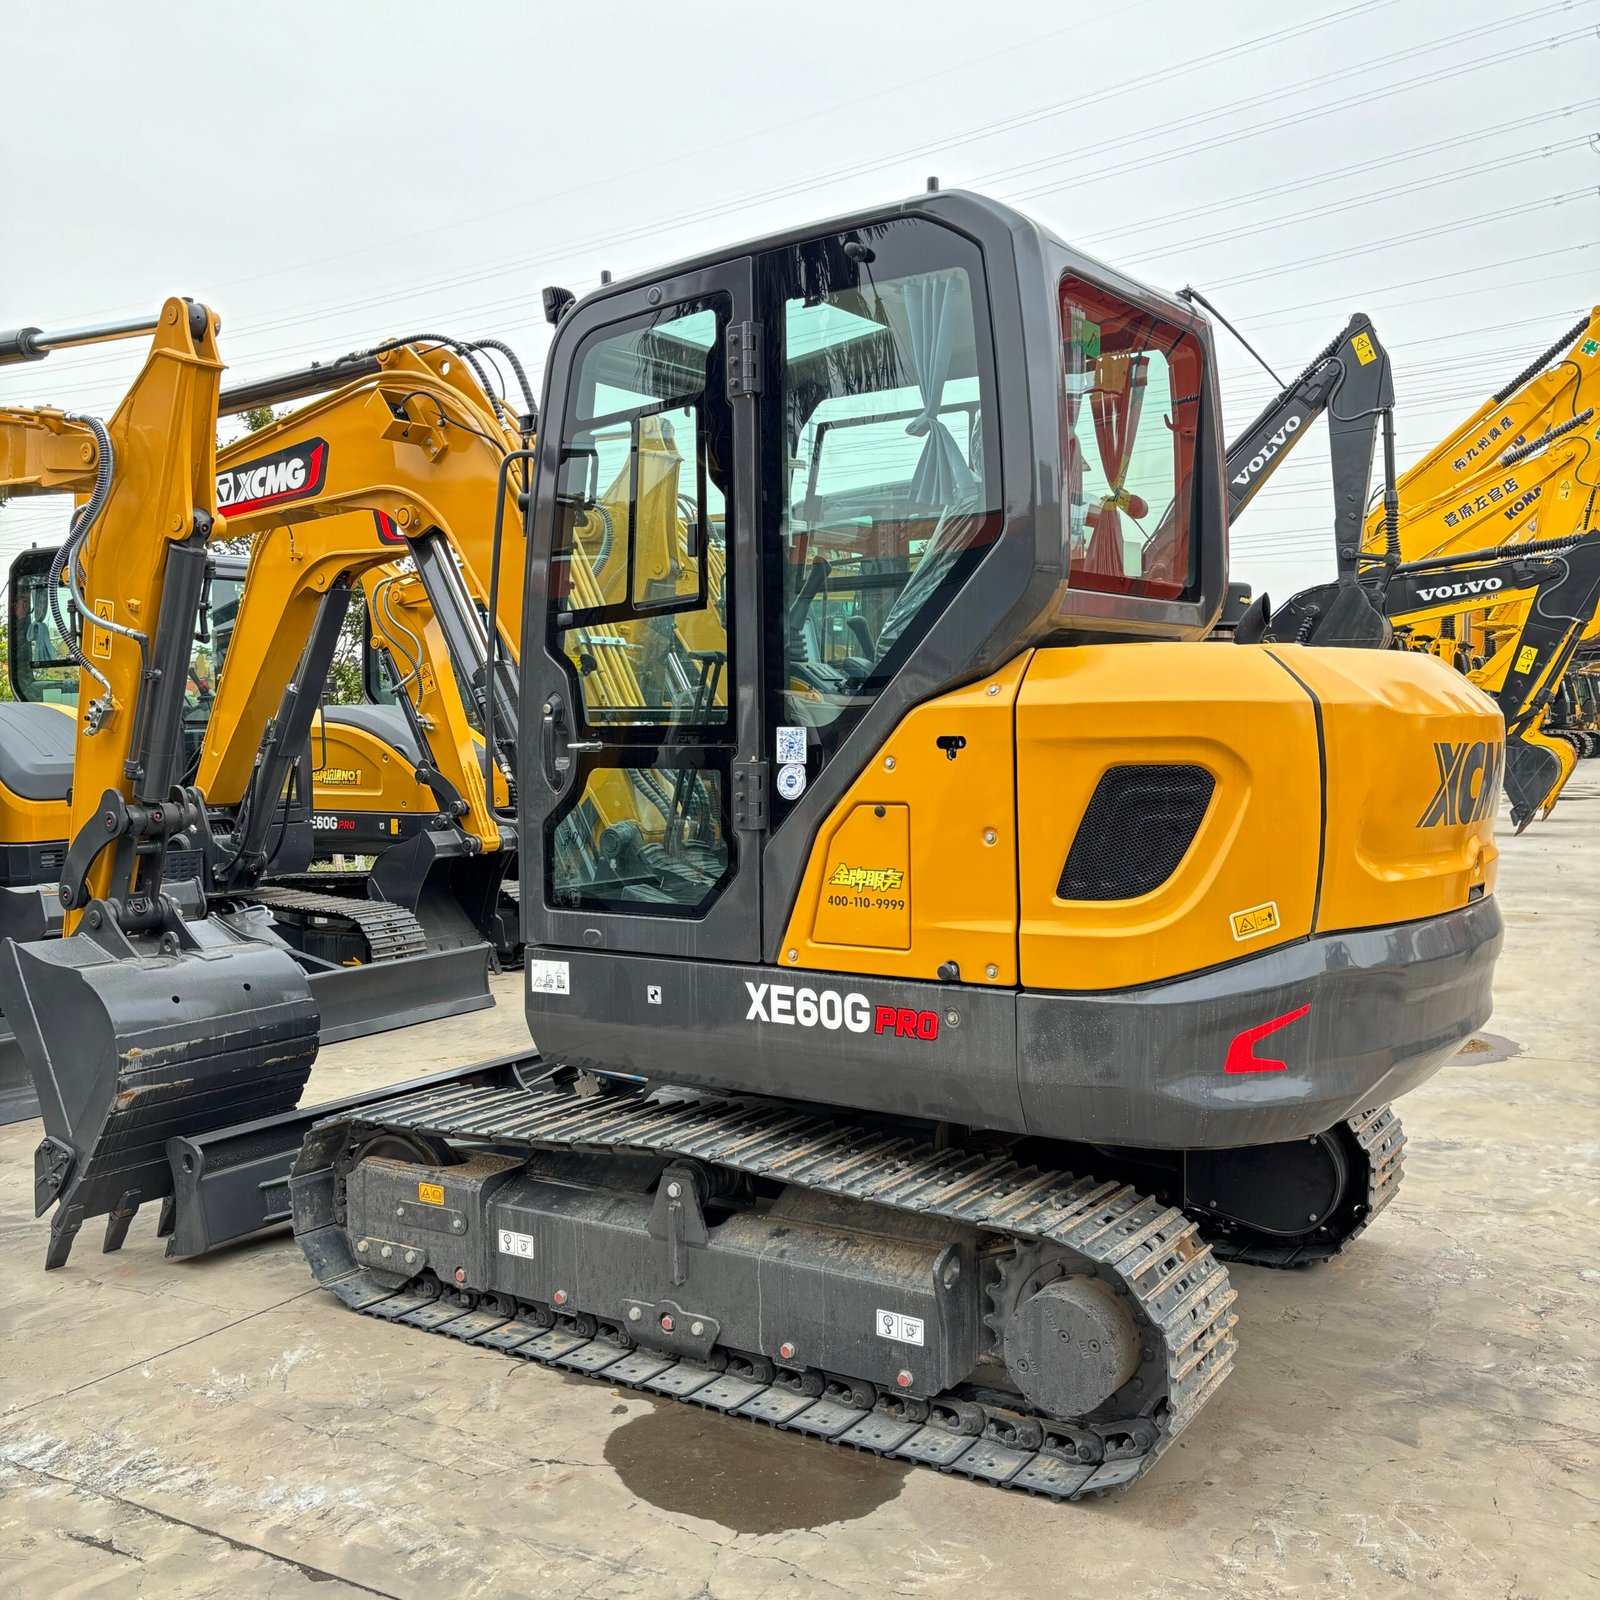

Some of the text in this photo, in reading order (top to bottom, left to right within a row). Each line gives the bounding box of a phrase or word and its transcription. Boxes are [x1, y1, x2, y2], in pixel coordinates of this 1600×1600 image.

[1232, 415, 1301, 485] VOLVO
[235, 458, 306, 504] XCMG
[1416, 577, 1503, 601] VOLVO
[338, 820, 355, 830] PRO
[829, 863, 904, 893] 金牌服务
[828, 895, 905, 911] 400-110-9999
[744, 982, 940, 1041] XE60G PRO
